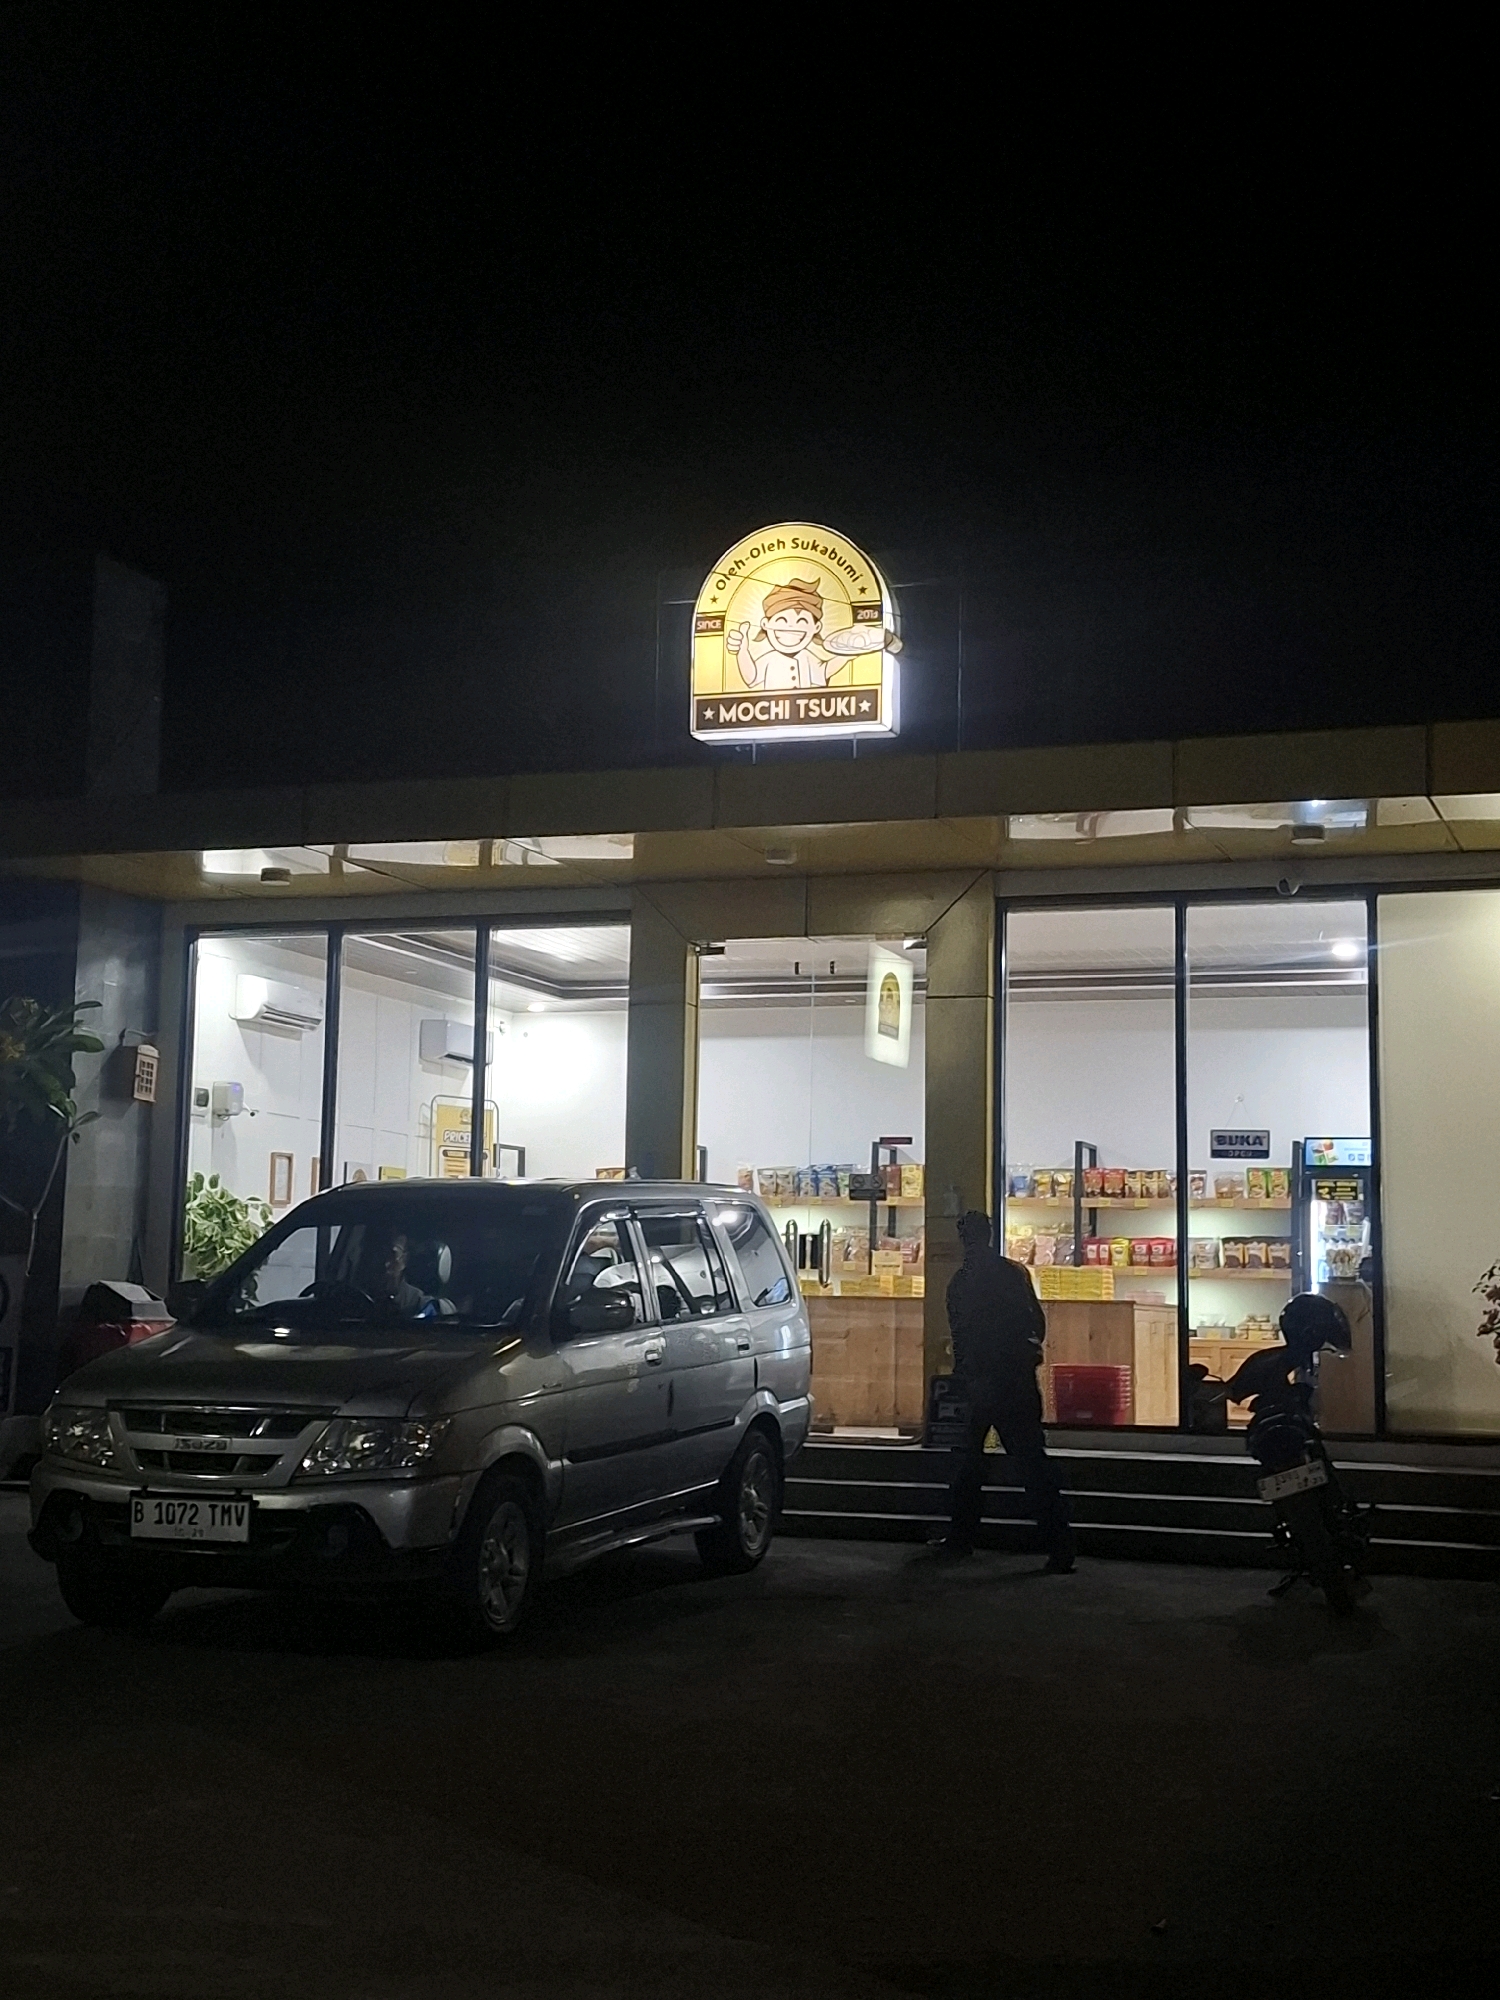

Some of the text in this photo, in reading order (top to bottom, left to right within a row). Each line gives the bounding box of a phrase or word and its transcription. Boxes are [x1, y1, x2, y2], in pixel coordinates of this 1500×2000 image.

[715, 537, 864, 592] Oleh-Oleh Sukabumi
[696, 619, 722, 631] SINCE
[718, 696, 857, 724] MOCHI TSUKI
[1214, 1134, 1264, 1147] BUKA
[134, 1501, 245, 1527] B 1072 TMV
